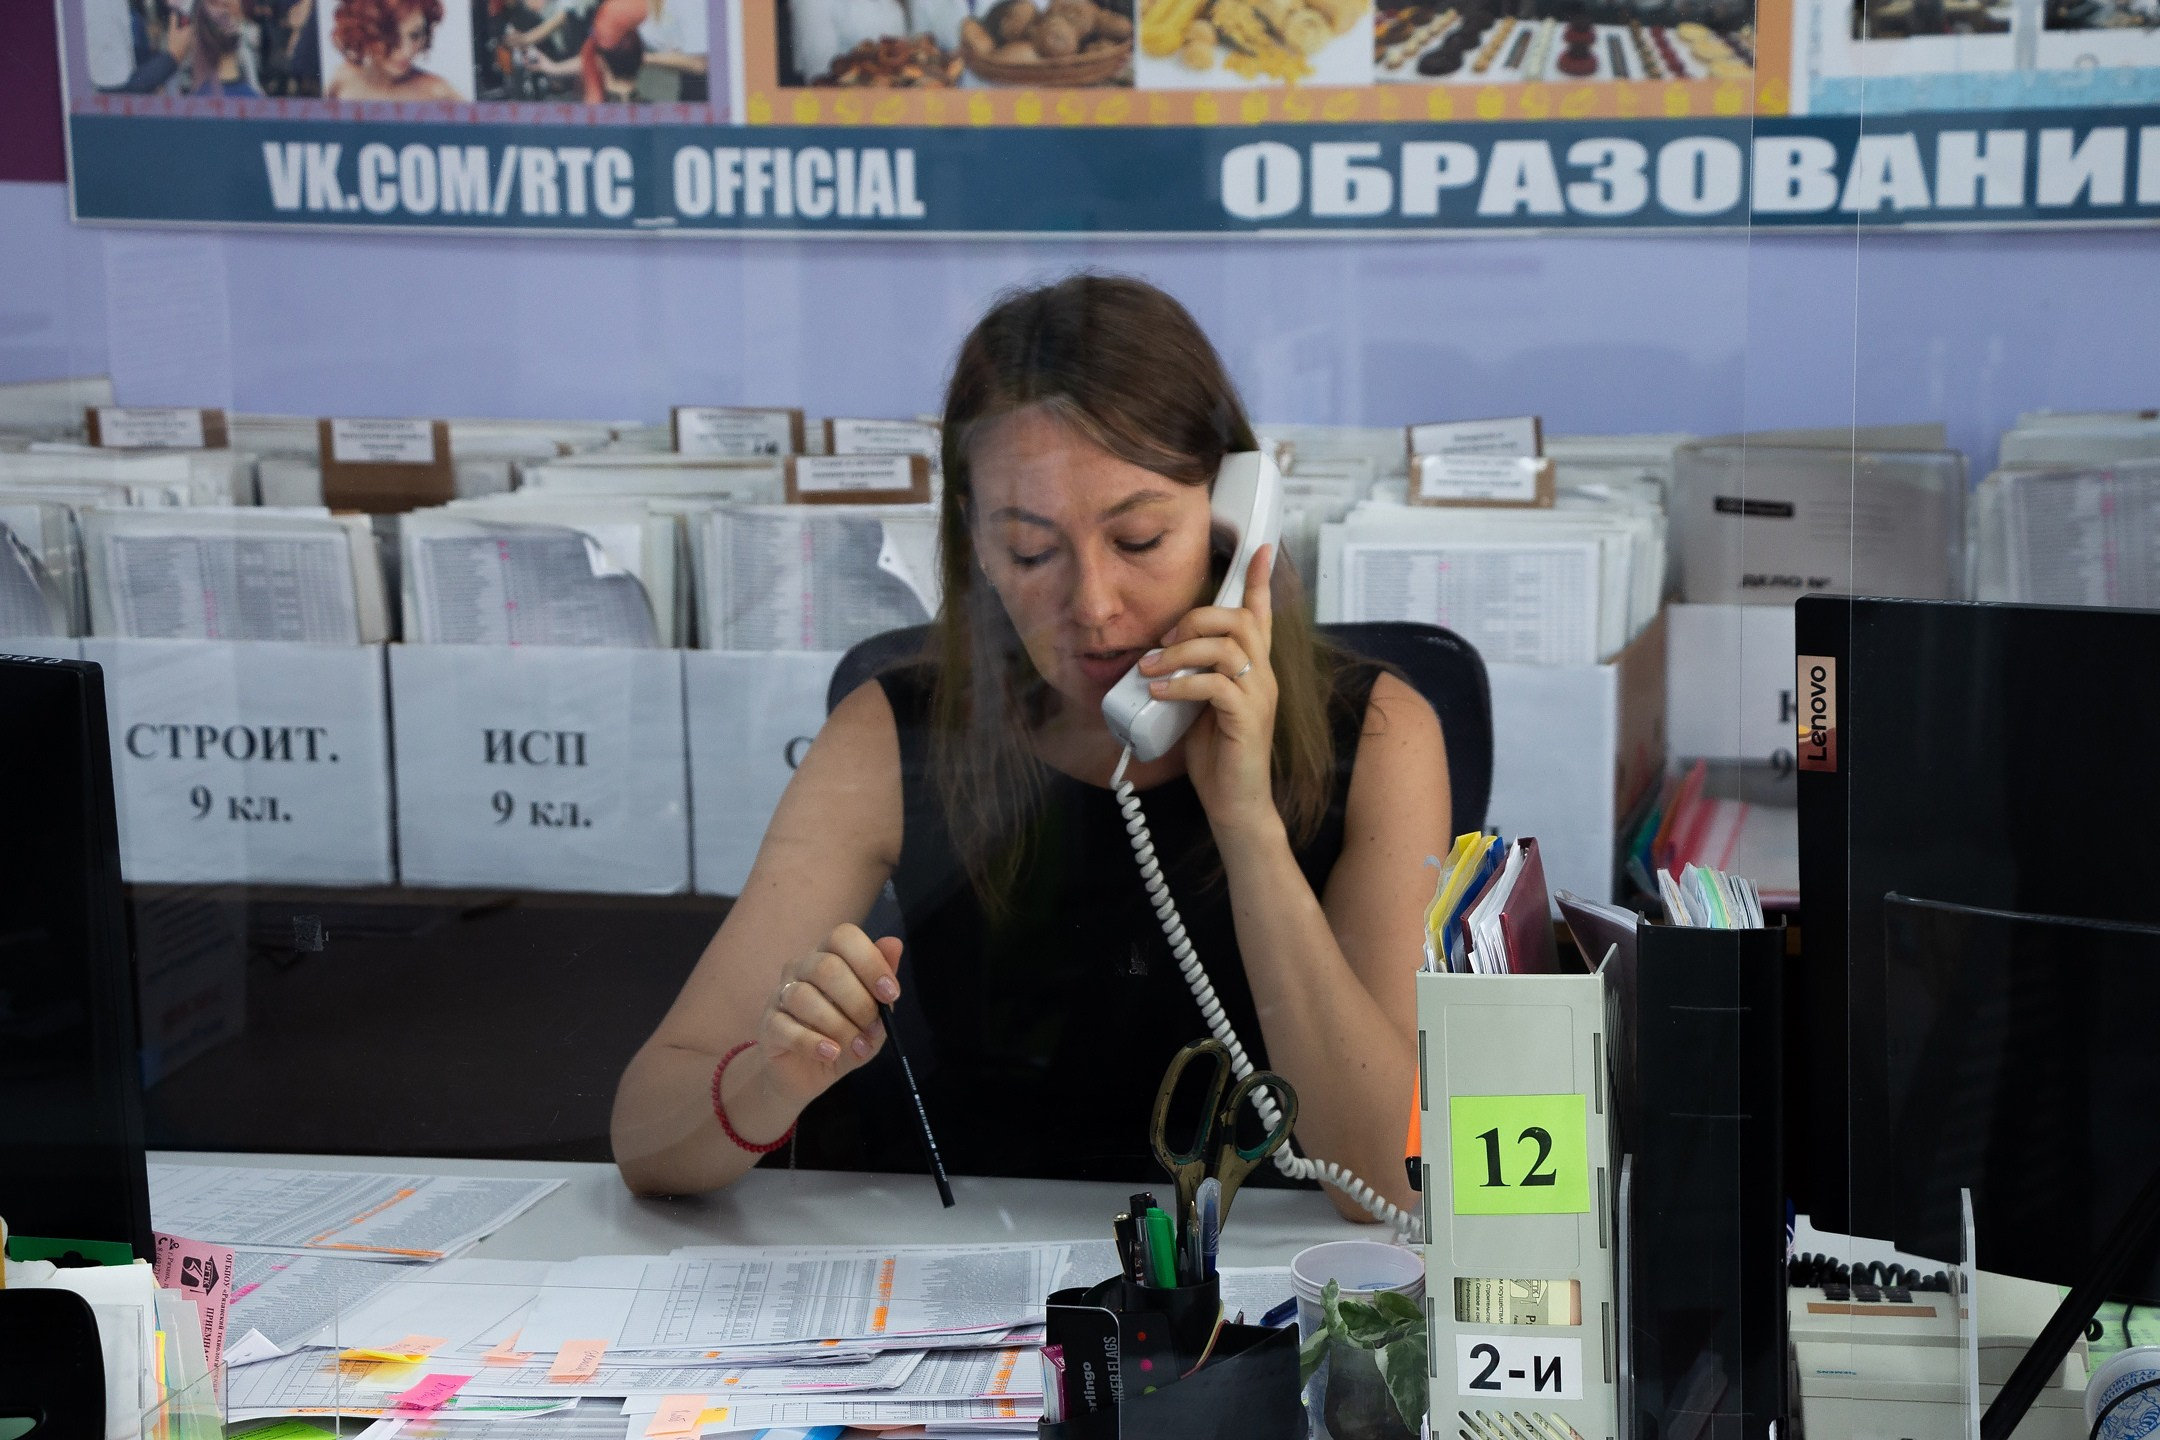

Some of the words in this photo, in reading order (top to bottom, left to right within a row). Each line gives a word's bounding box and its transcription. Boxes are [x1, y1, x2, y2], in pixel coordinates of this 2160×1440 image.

[263, 141, 925, 227] VK.COM/RTC_OFFICIAL
[1807, 665, 1827, 761] Lenovo
[125, 725, 338, 763] СТРОИТ.
[484, 729, 586, 767] ИСП
[190, 786, 213, 818] 9
[228, 796, 291, 823] кл.
[491, 791, 514, 823] 9
[530, 801, 592, 828] кл.
[1475, 1126, 1557, 1188] 12
[203, 1262, 212, 1286] РГТК
[223, 1253, 233, 1288] ОГБПОУ
[1103, 1336, 1121, 1371] FLAGS
